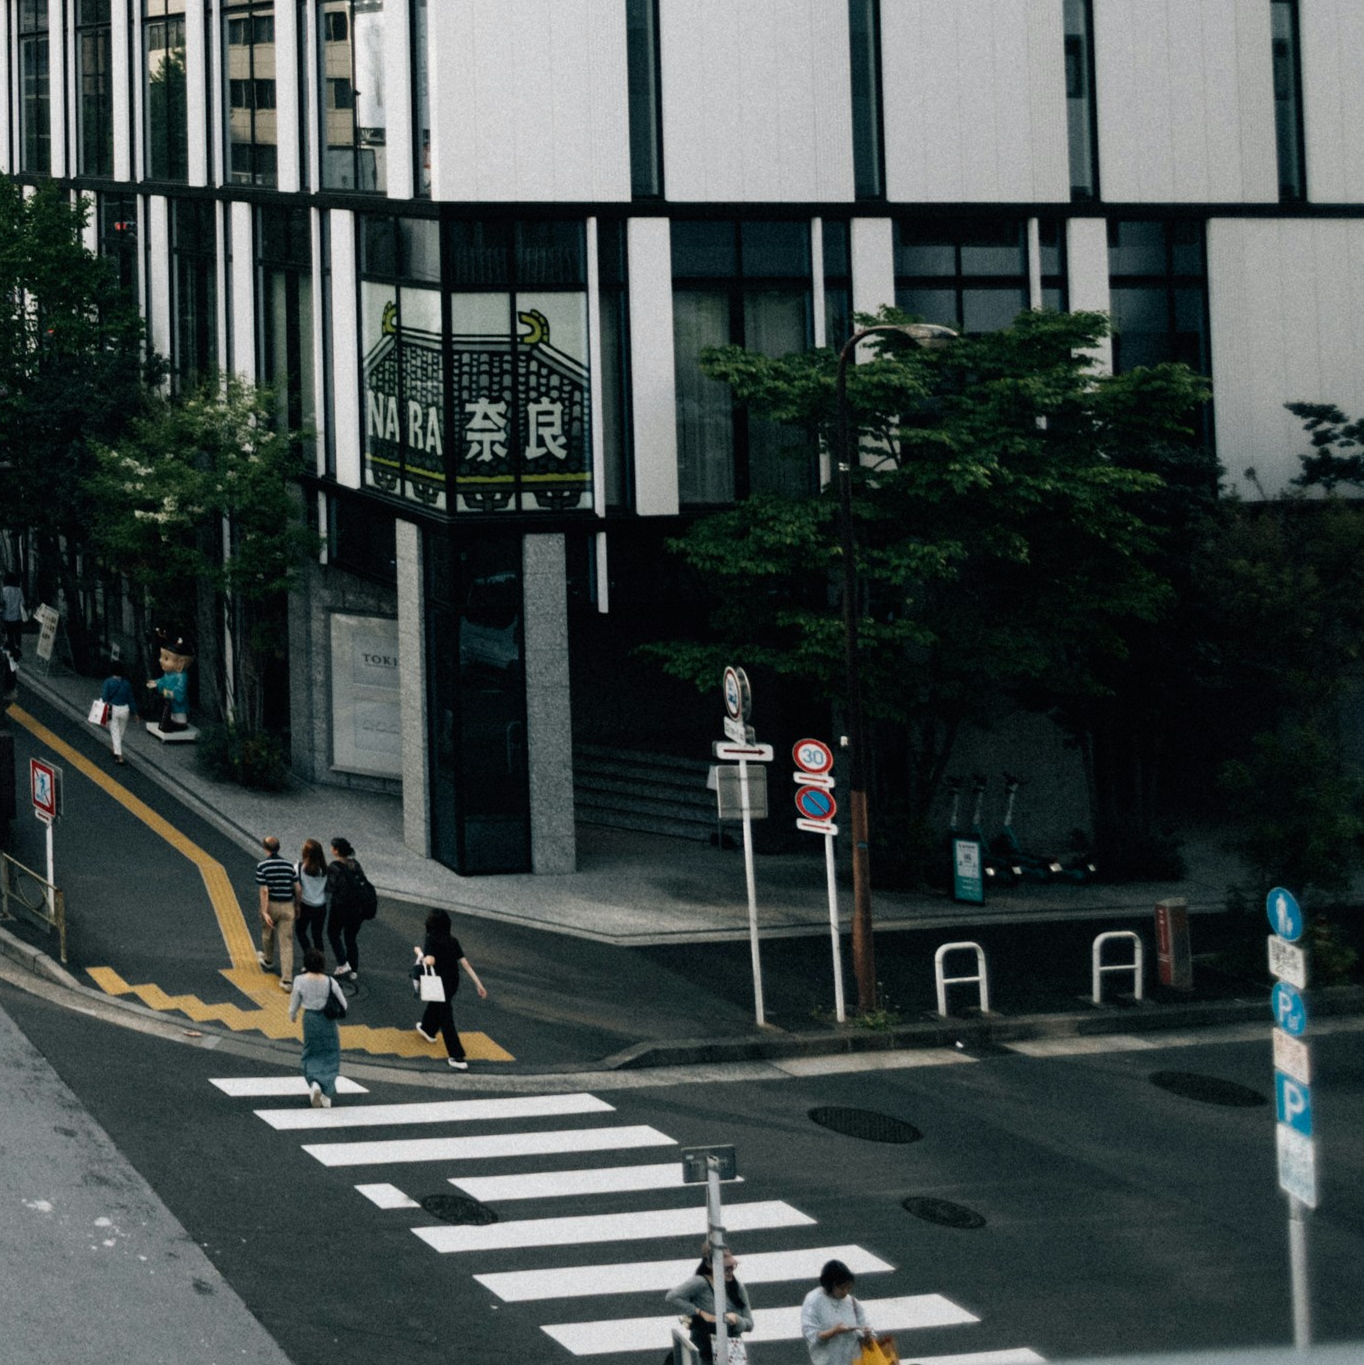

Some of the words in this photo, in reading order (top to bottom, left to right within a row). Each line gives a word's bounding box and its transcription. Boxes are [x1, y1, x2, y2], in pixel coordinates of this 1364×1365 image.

[367, 391, 444, 456] NARA
[464, 396, 569, 463] 奈良
[802, 748, 824, 766] 30
